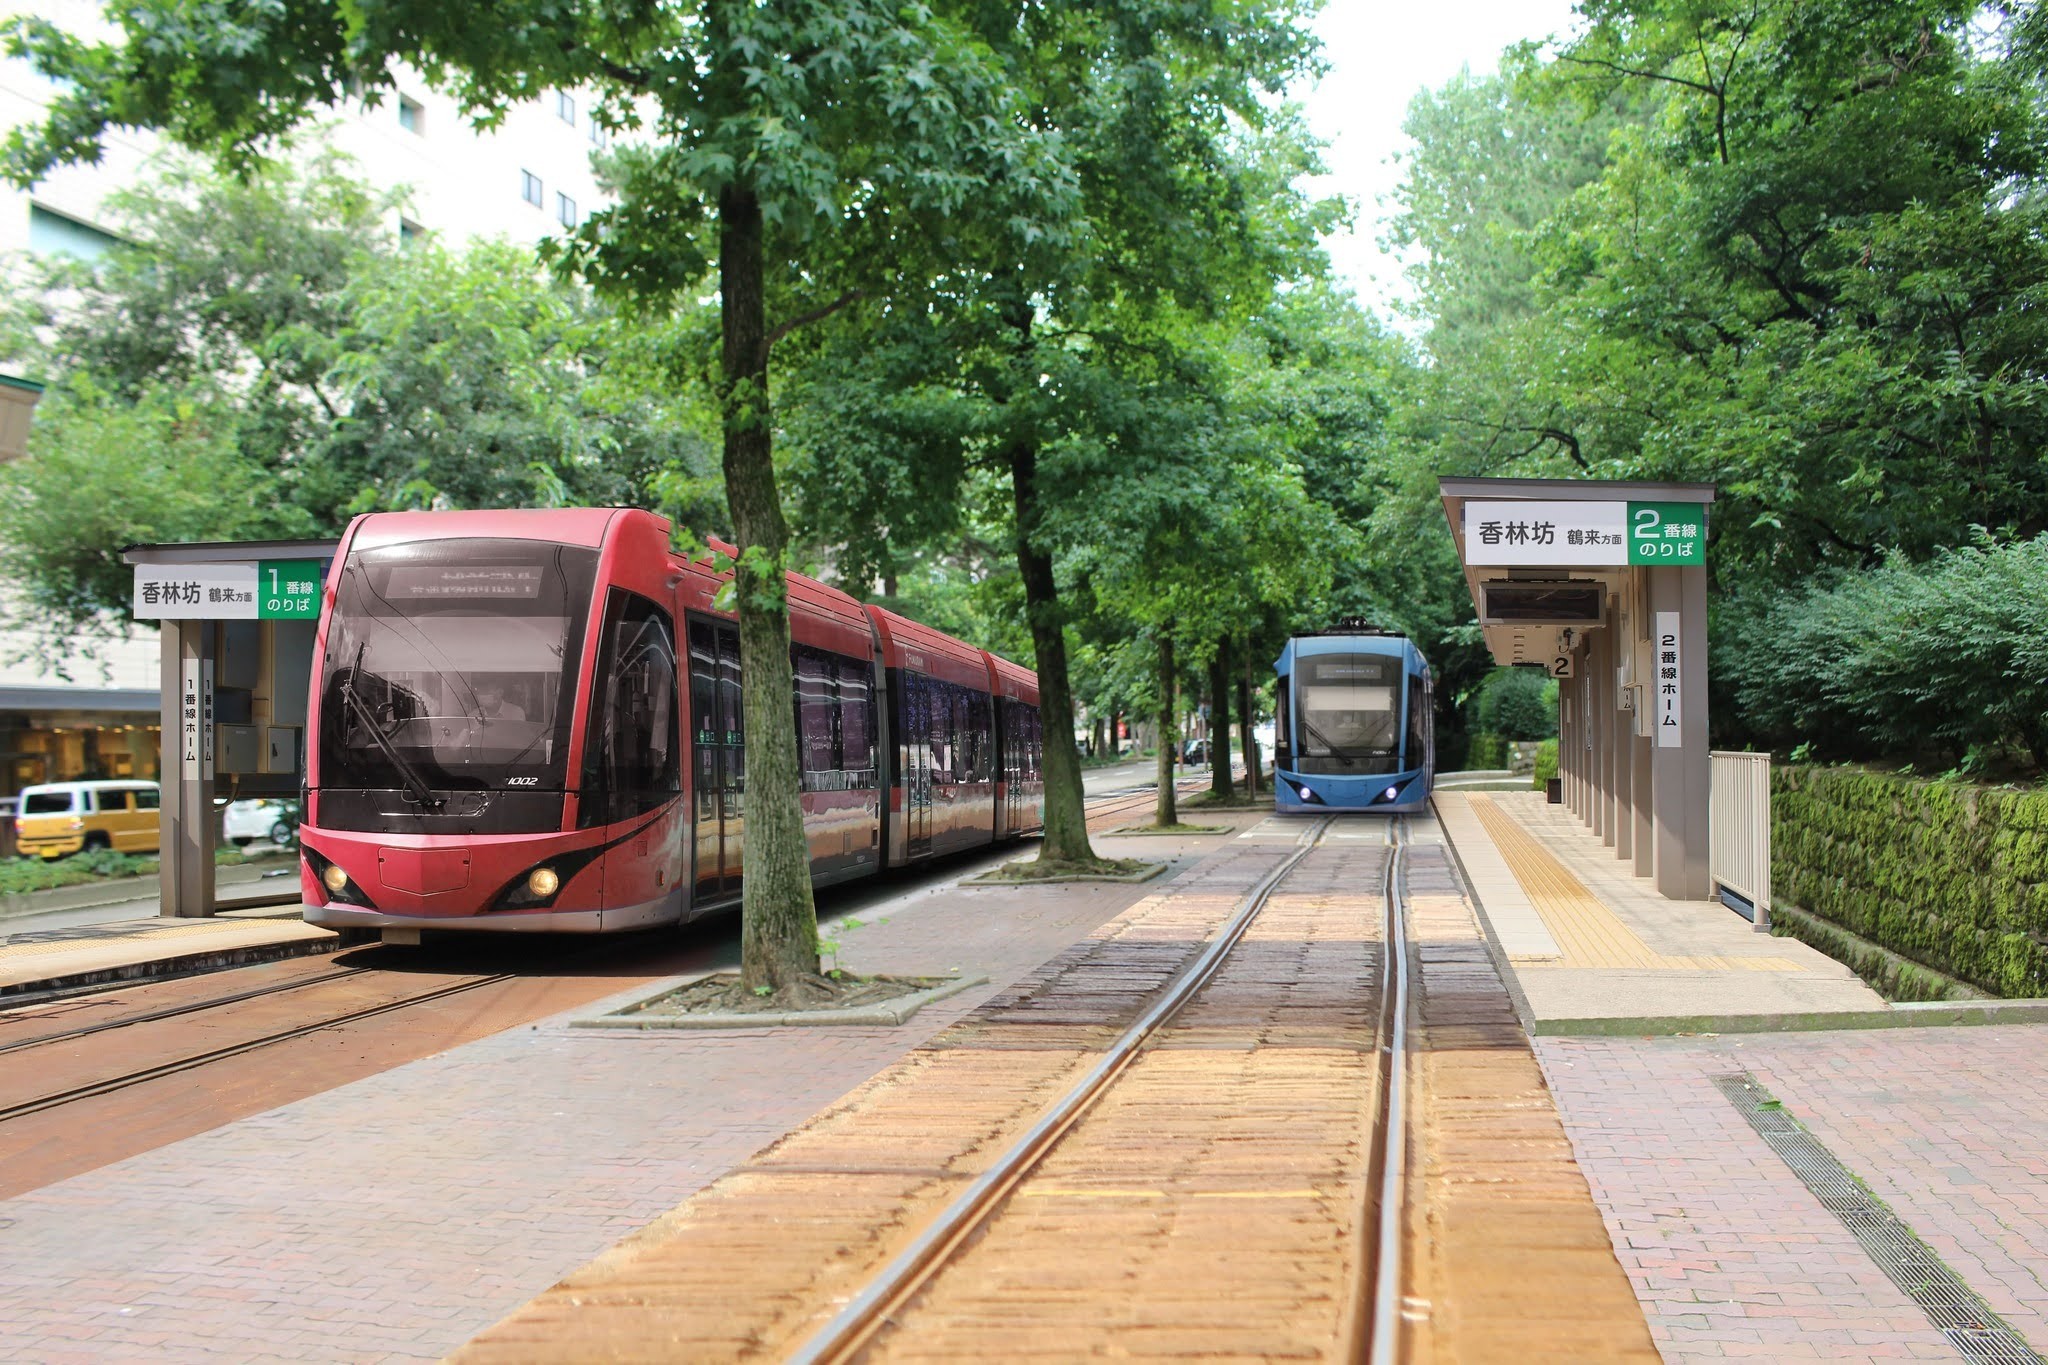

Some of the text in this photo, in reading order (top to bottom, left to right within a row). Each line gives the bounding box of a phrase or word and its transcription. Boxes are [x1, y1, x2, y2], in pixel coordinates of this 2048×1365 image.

[1478, 520, 1622, 546] 香林坊 鶴来方面
[1633, 509, 1697, 539] 2番線
[1639, 541, 1694, 557] のりば
[142, 581, 253, 605] 香林坊 鶴来方面
[268, 568, 314, 595] 1番線
[267, 597, 311, 612] のりば
[1554, 656, 1569, 676] 2
[1660, 634, 1678, 727] 2番線ホーム
[184, 679, 197, 762] 1番線ホーム
[204, 679, 212, 762] 1番線ホーム
[507, 777, 539, 786] 1002
